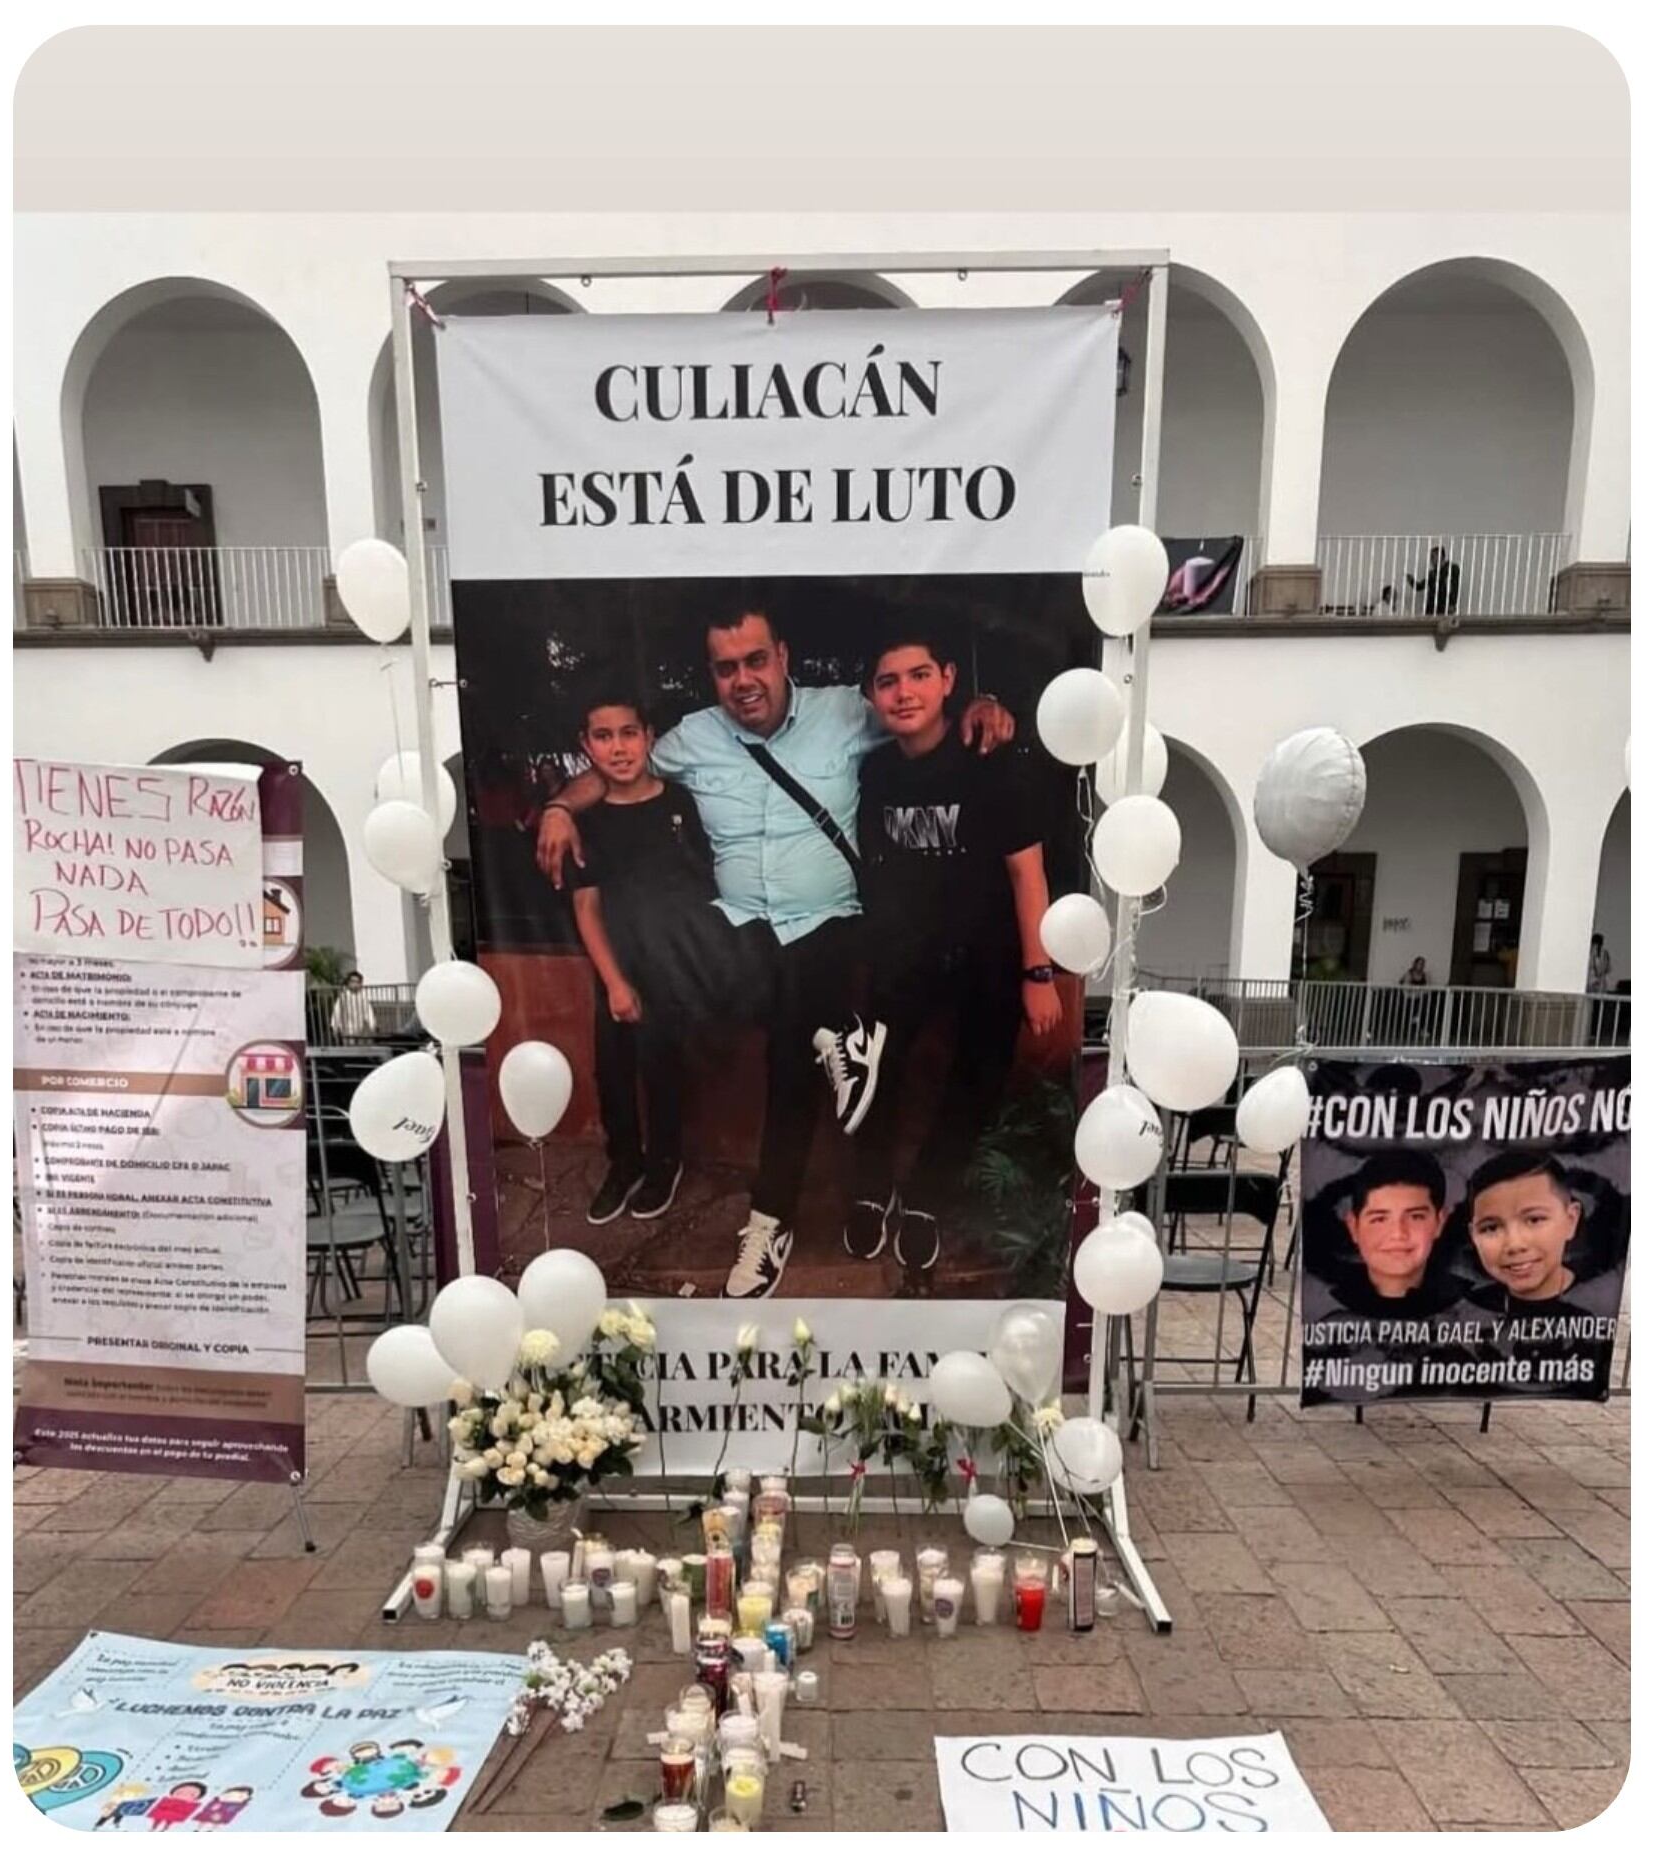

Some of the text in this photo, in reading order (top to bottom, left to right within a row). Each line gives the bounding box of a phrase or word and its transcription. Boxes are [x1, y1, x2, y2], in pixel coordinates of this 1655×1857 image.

[594, 343, 943, 422] CULIACÁN
[539, 453, 1016, 527] ESTÁ DE LUTO
[13, 759, 170, 822] TIENES
[25, 818, 234, 867] ROCHA! NO PASA
[885, 804, 960, 849] DKNY
[55, 861, 149, 896] NADA
[30, 888, 258, 947] PASA DE TODO!!
[41, 1076, 129, 1088] POR COMERCIO
[1301, 1094, 1396, 1139] #CON
[1405, 1095, 1474, 1140] LOS
[1482, 1088, 1586, 1141] NIÑOS
[88, 1336, 148, 1348] PRESENTAR
[204, 1343, 211, 1353] Y
[213, 1343, 249, 1354] COPIA
[1378, 1321, 1431, 1344] PARA
[1437, 1320, 1484, 1344] GAEL
[1491, 1318, 1504, 1342] Y
[1508, 1316, 1616, 1341] ALEXANDER
[707, 1350, 805, 1380] PARA
[820, 1350, 867, 1379] LA
[1304, 1352, 1595, 1392] #Ningun inocente más
[961, 1741, 1279, 1788] CON LOS
[1012, 1787, 1268, 1832] NIÑOS
